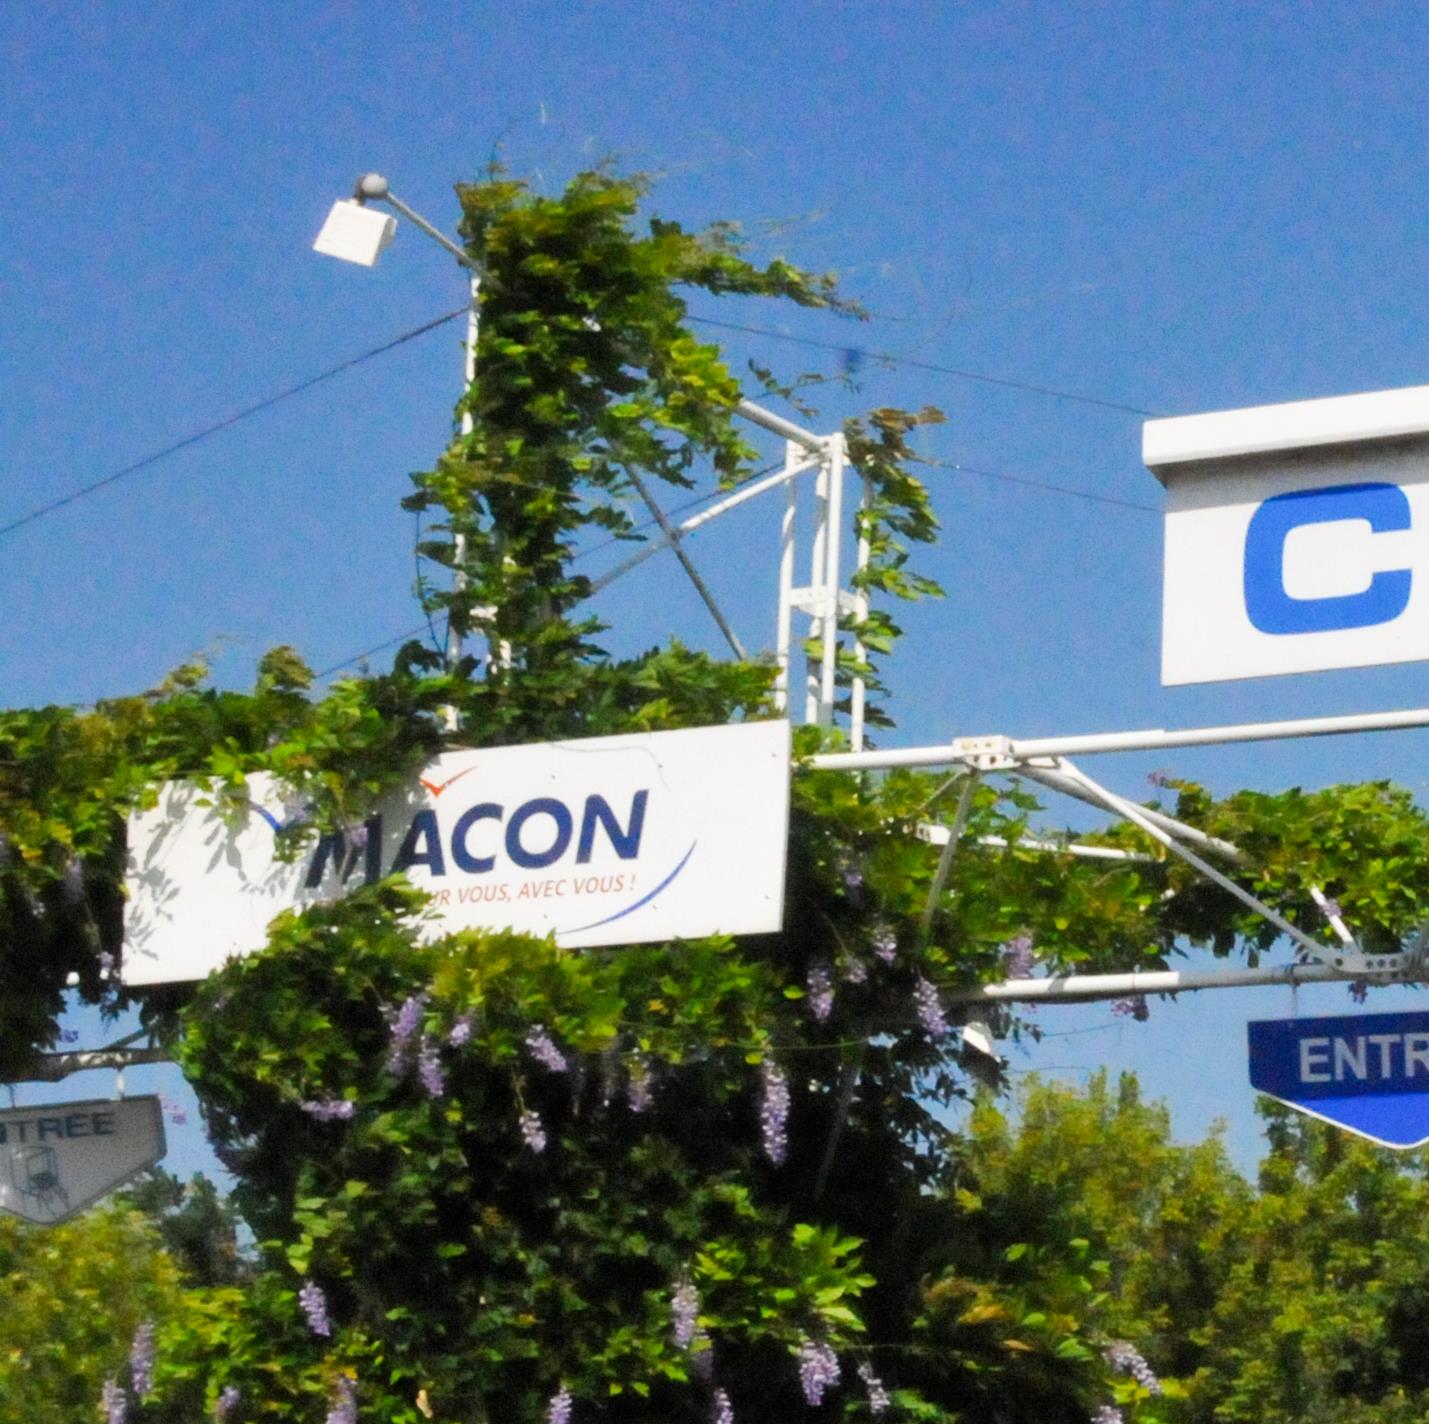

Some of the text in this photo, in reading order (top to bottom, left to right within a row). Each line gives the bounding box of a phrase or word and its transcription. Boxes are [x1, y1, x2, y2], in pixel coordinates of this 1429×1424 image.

[458, 883, 512, 904] VOUS,
[517, 879, 568, 900] AVEC
[573, 874, 624, 895] VOUS
